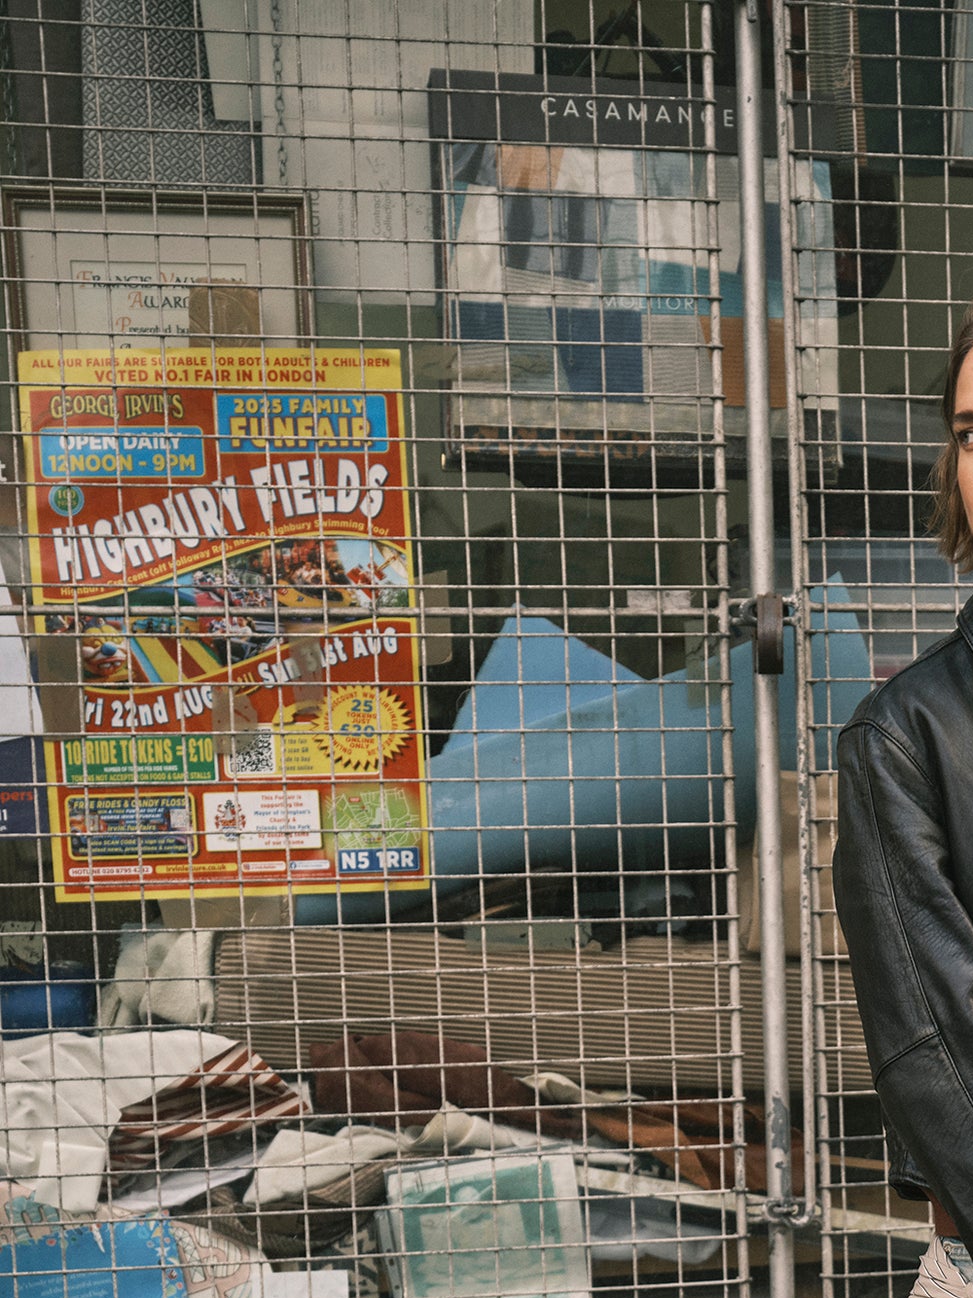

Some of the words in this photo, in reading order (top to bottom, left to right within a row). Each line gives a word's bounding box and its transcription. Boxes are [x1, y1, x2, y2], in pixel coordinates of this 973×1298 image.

[32, 359, 55, 368] ALL
[58, 358, 82, 368] OUR
[86, 357, 120, 367] FAIRS
[124, 357, 147, 367] ARE
[151, 356, 207, 367] SUITABLE
[238, 356, 270, 367] BOTH
[321, 357, 329, 367] &
[95, 370, 149, 383] VOTED
[154, 369, 189, 382] NO.1
[194, 369, 231, 382] FAIR
[236, 369, 253, 382] IN
[258, 369, 326, 383] LONDON
[50, 394, 120, 420] GEORGE
[233, 397, 283, 414] 2025
[288, 397, 366, 414] FAMILY
[59, 432, 117, 450] OPEN
[122, 431, 183, 450] DAILY
[229, 416, 374, 449] FUNFAIR
[48, 453, 133, 473] 12NOON
[152, 453, 196, 472] 9PM
[51, 475, 247, 583] HIGHBURY
[249, 457, 390, 524] FIELDS
[110, 695, 169, 728] 22nd
[352, 626, 399, 659] AUG
[346, 711, 378, 719] TOKENS
[351, 698, 373, 713] 25
[65, 741, 81, 766] 10
[85, 739, 118, 764] RIDE
[187, 737, 214, 762] £10
[340, 851, 370, 870] N5
[375, 850, 415, 868] 1RR
